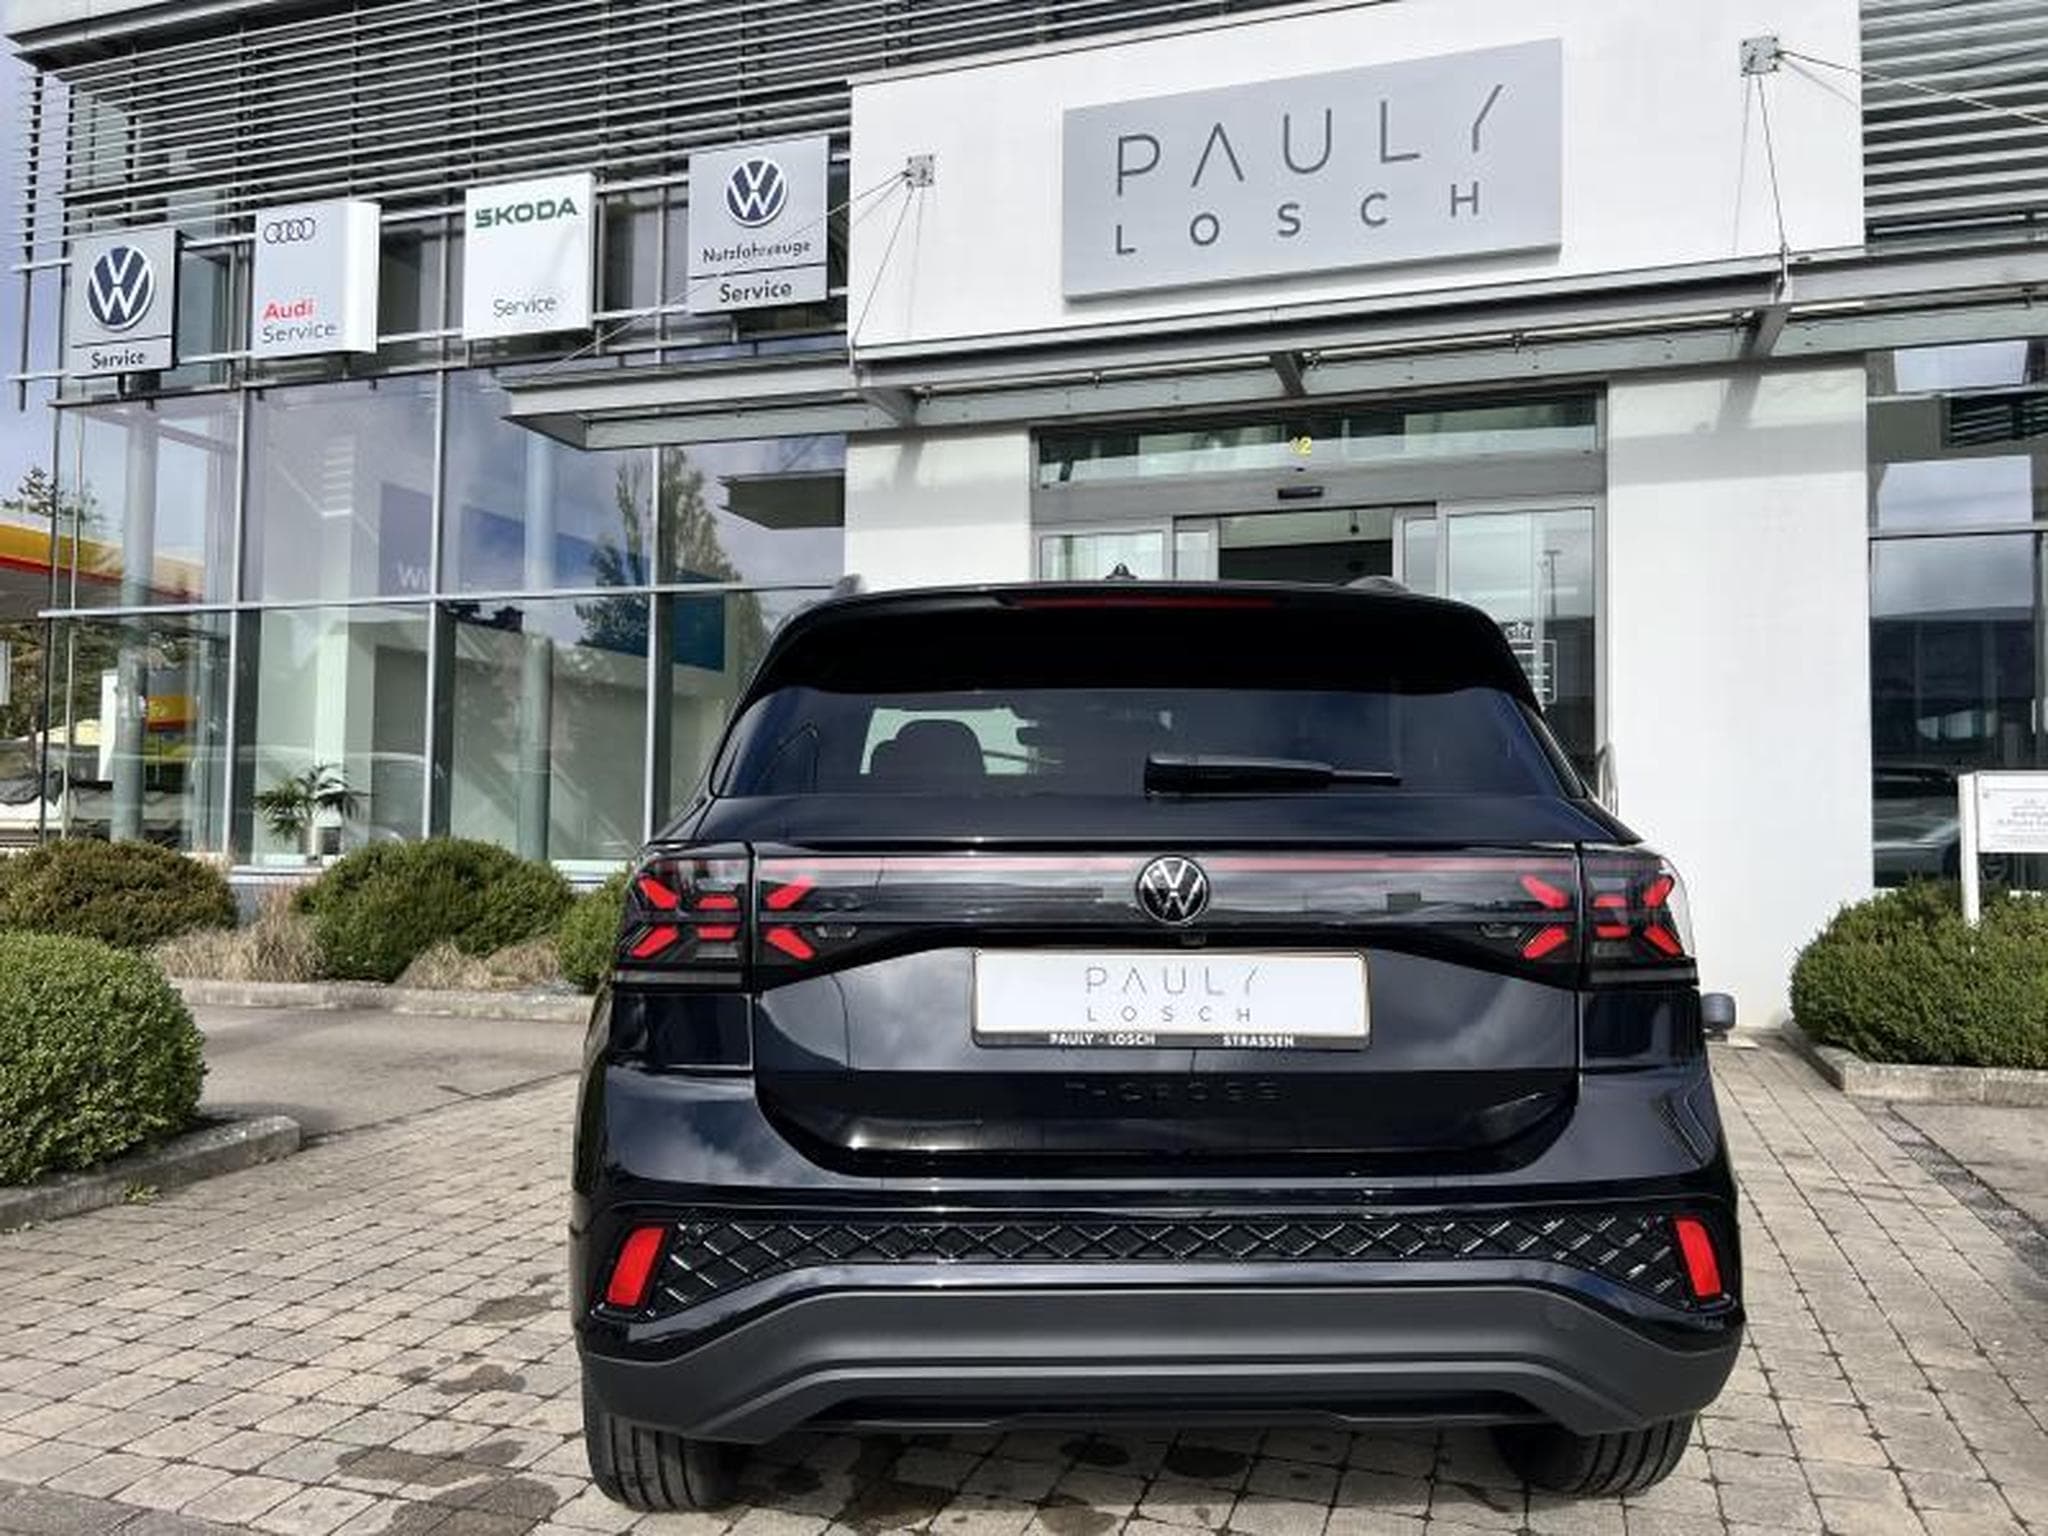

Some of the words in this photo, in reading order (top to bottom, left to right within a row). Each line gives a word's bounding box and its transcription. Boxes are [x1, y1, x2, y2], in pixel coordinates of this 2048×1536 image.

[1116, 83, 1504, 197] PAULY
[1115, 181, 1480, 256] LOSCH
[702, 241, 812, 263] Nutzfahrzeuge
[719, 278, 793, 303] Service
[263, 299, 315, 321] Audi
[493, 294, 558, 318] Service
[262, 322, 338, 344] Service
[91, 349, 146, 370] Service
[1086, 966, 1259, 995] PAULY
[1086, 1005, 1251, 1023] LOSCH
[1049, 1033, 1094, 1046] PAULY
[1108, 1033, 1156, 1046] LOSCH
[1222, 1034, 1295, 1048] STRASSEN
